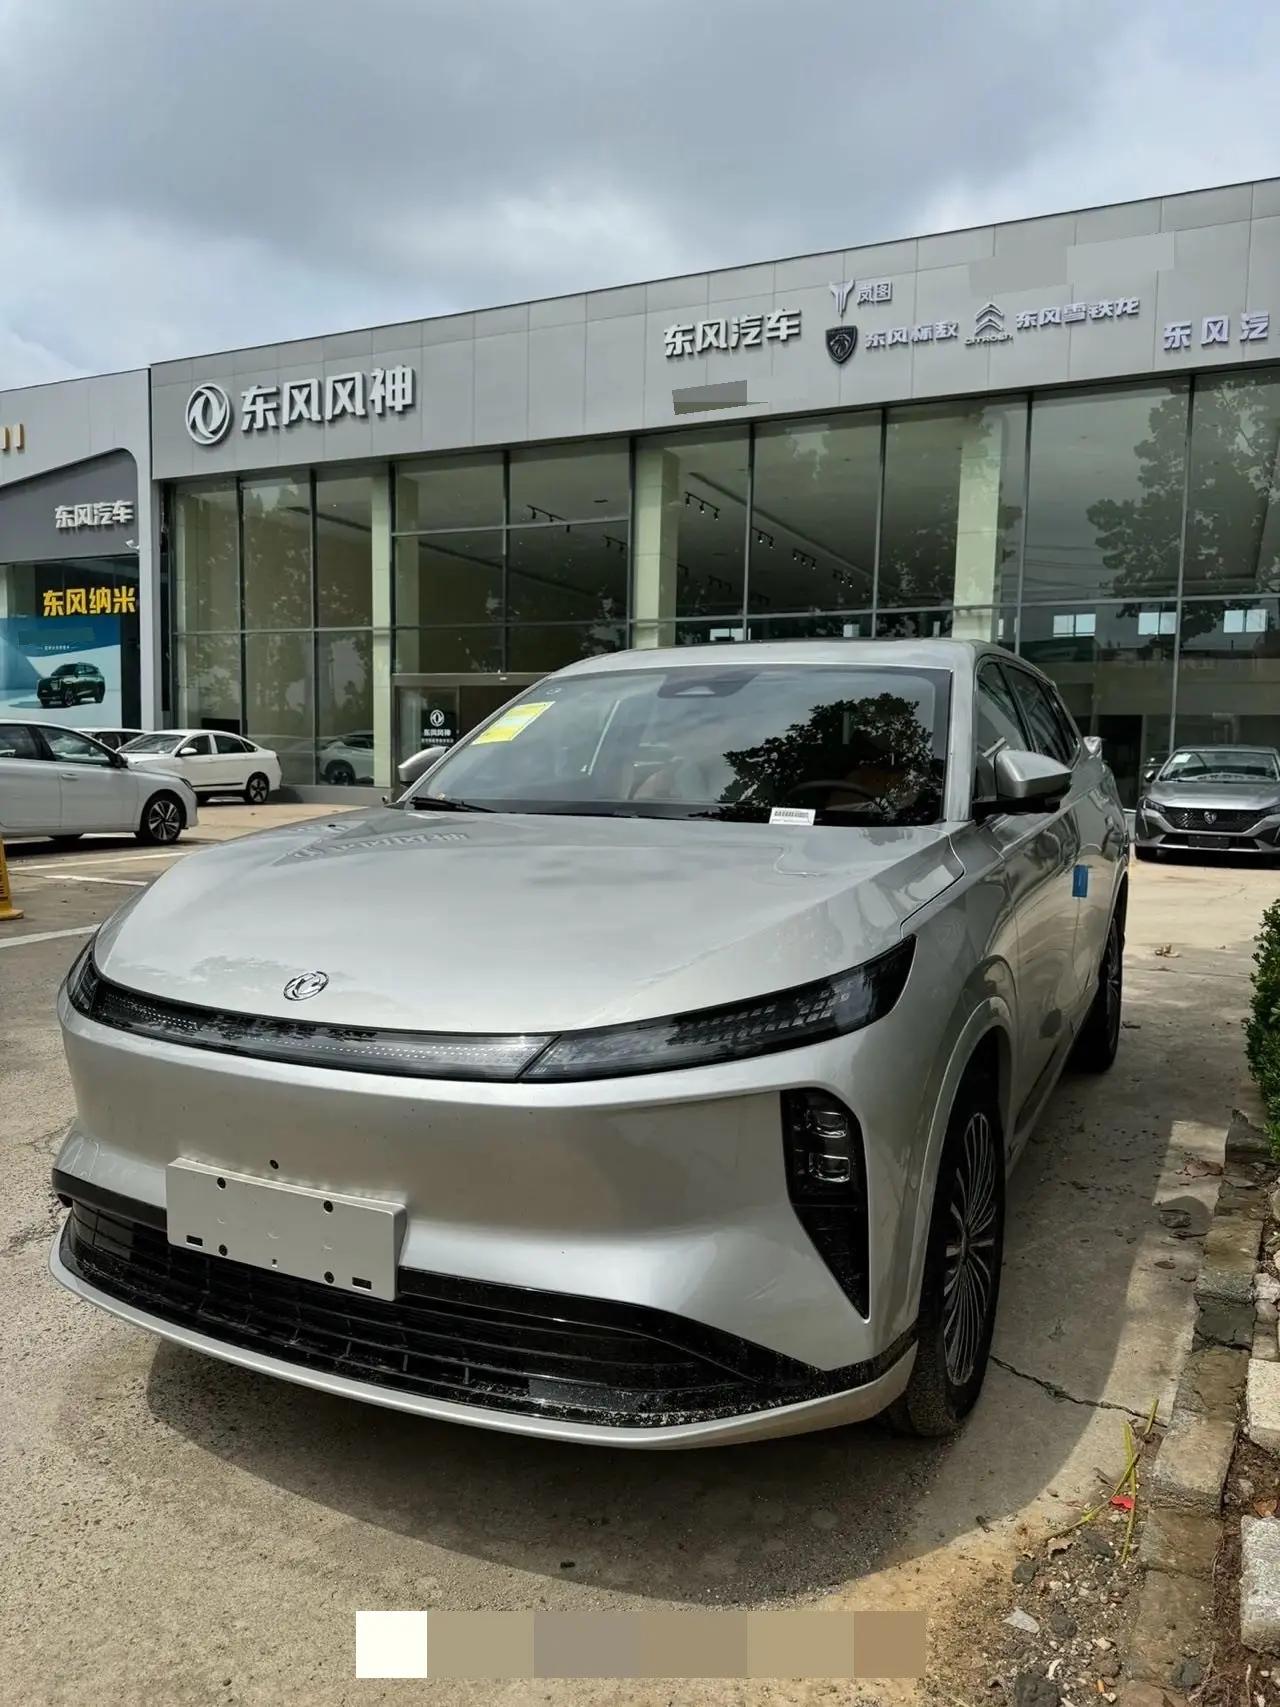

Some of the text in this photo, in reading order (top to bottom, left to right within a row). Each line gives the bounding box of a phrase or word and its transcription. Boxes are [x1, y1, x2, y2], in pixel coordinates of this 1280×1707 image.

[1016, 297, 1140, 330] 东风雪铁龙
[664, 308, 801, 358] 东风汽车
[240, 365, 416, 431] 东风风神
[55, 500, 134, 529] 东风汽车
[43, 586, 136, 616] 东风纳米
